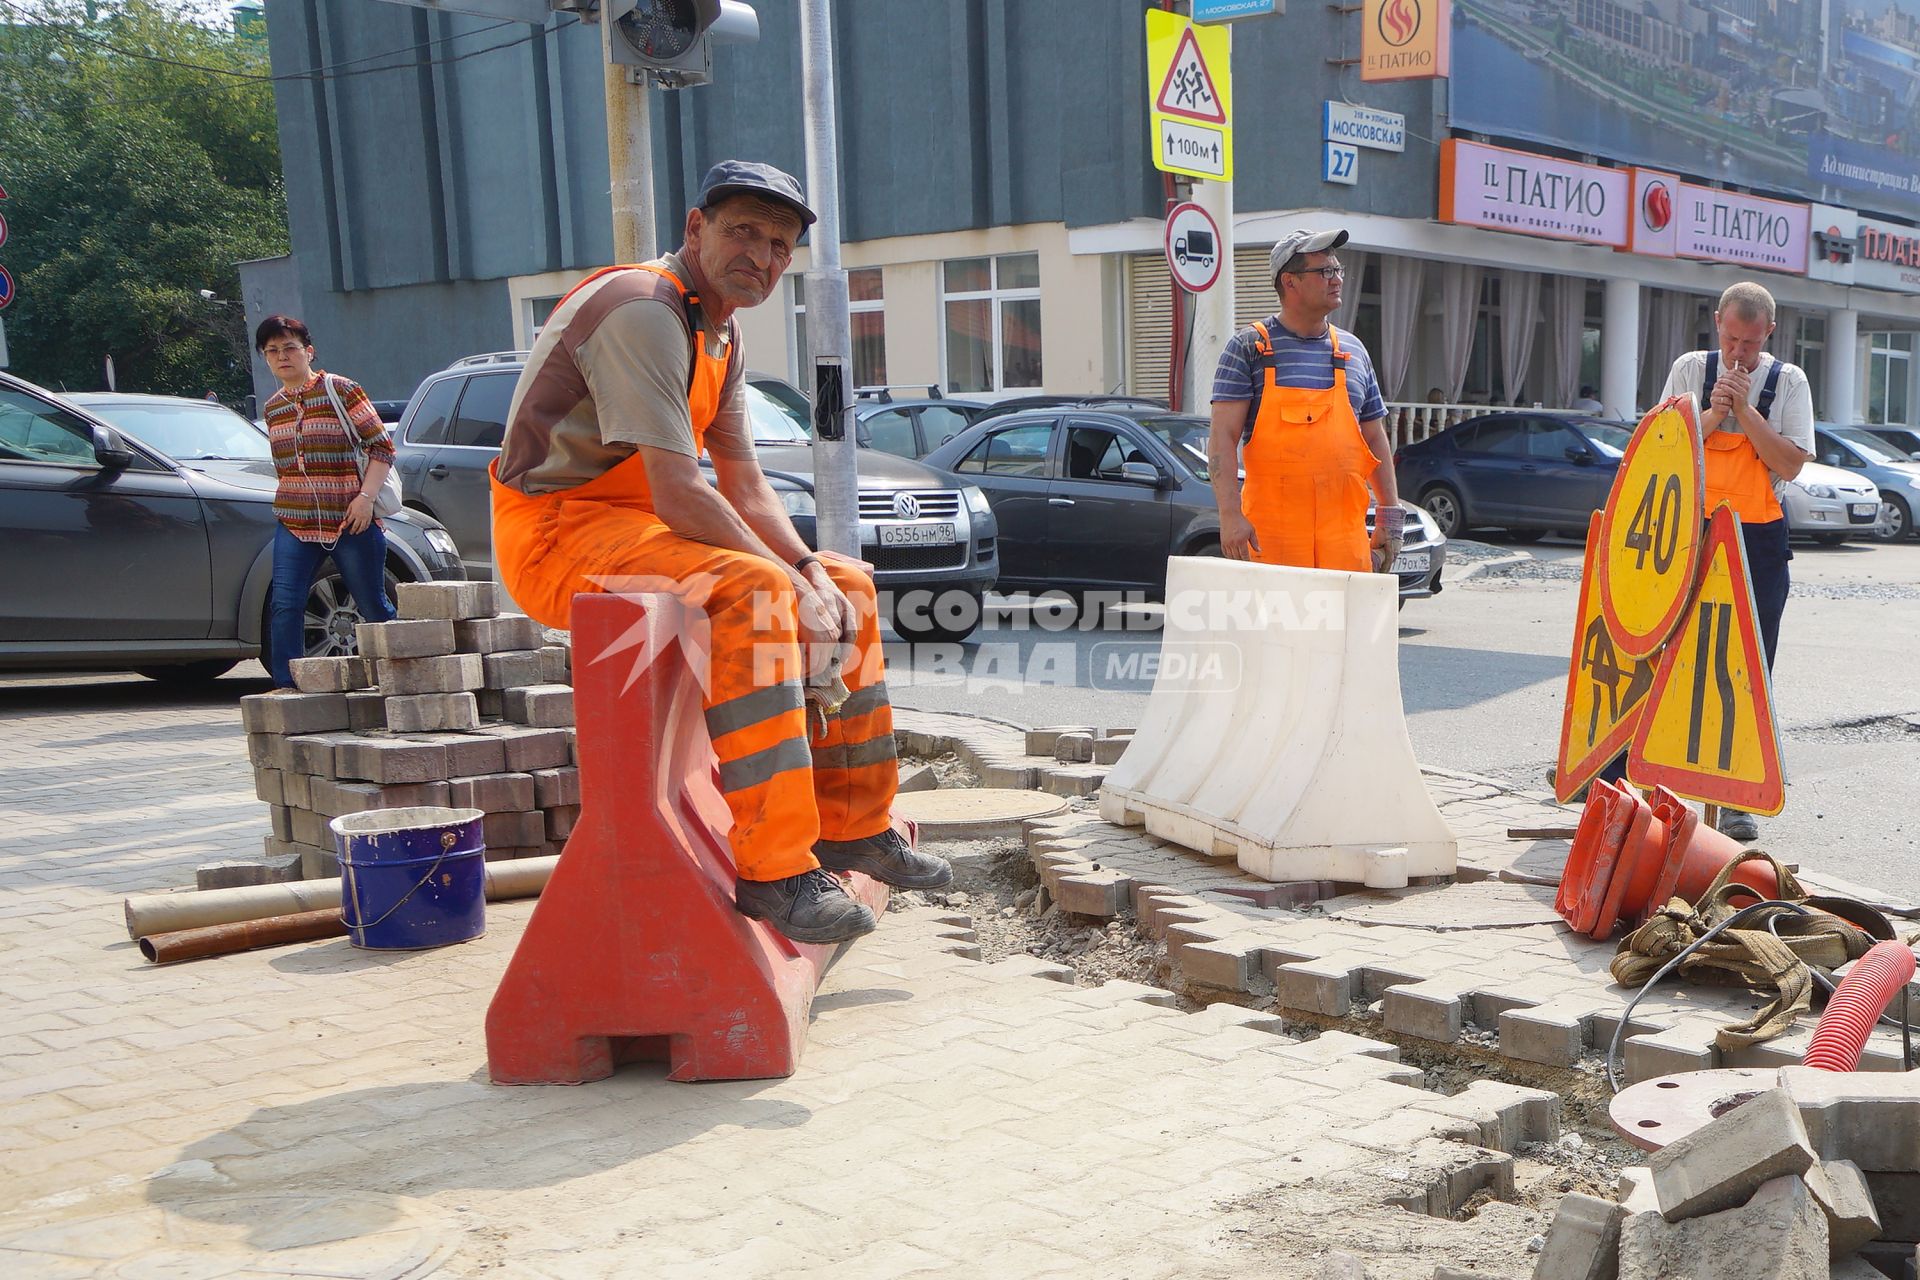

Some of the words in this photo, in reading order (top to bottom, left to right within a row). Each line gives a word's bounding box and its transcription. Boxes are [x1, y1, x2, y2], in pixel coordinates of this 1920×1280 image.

[1368, 55, 1376, 65] IL
[1380, 50, 1431, 69] ПАТИО
[1332, 120, 1402, 145] МОСКОВСКАЯ
[1332, 149, 1355, 177] 27
[1484, 162, 1499, 187] IL
[1820, 154, 1909, 190] Администрация
[1506, 166, 1605, 217] ПАТИО
[1483, 211, 1518, 224] пицца
[1529, 217, 1561, 230] паста
[1570, 223, 1602, 236] гриль
[1694, 201, 1706, 222] IL
[1712, 204, 1789, 248] ПАТИО
[939, 525, 951, 537] 96
[1625, 473, 1681, 575] 40
